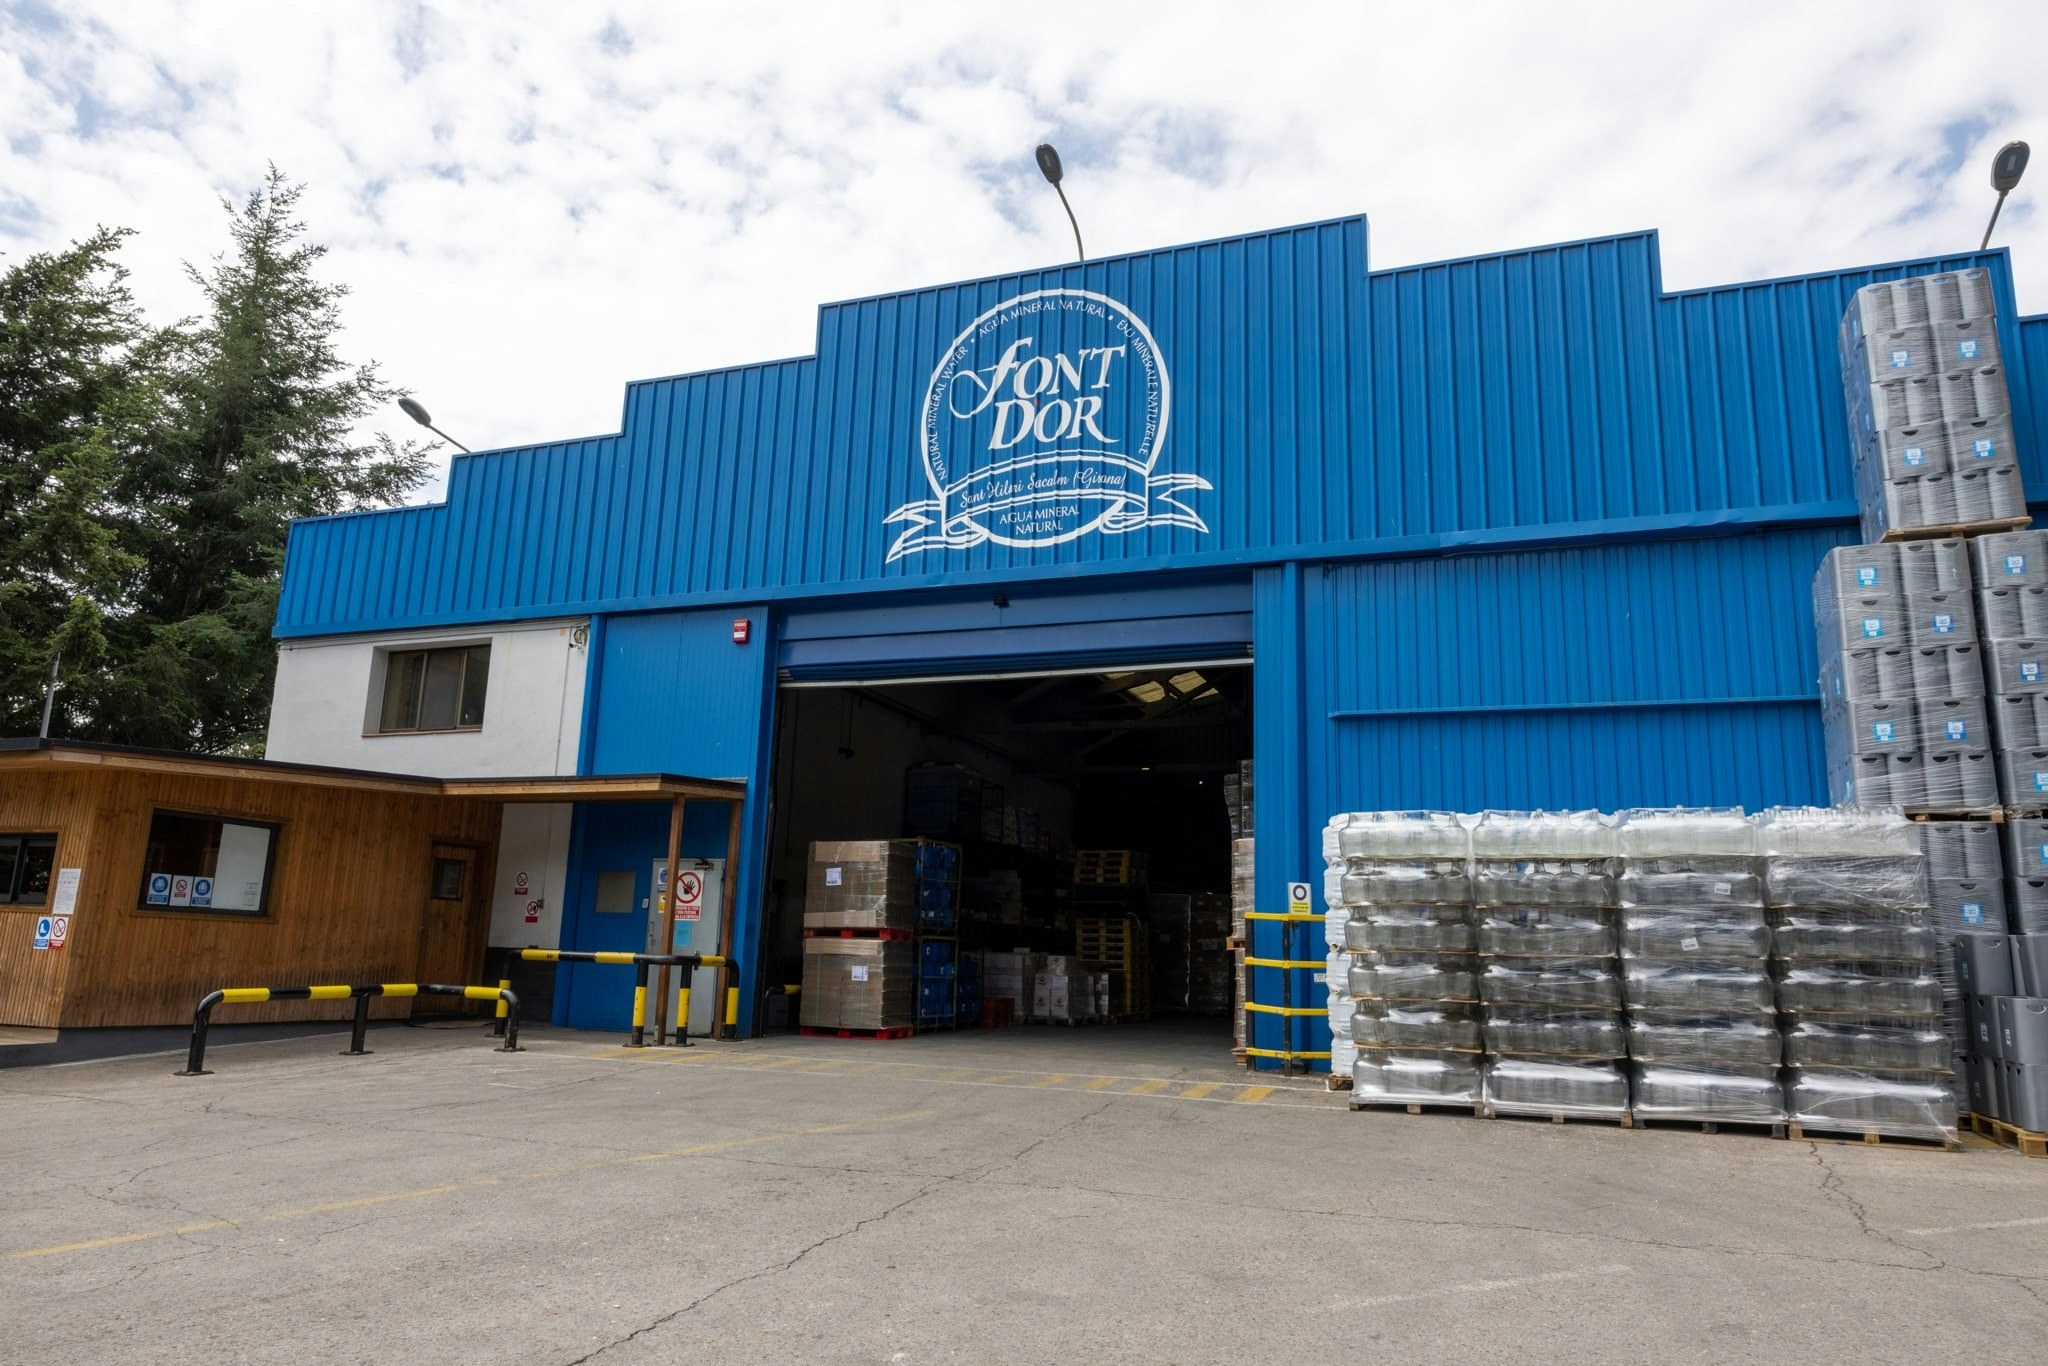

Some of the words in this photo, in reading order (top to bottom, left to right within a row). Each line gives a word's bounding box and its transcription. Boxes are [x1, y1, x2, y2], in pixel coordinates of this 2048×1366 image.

[979, 315, 1009, 338] AGUA
[1010, 301, 1056, 320] MINERAL
[1059, 299, 1106, 319] NATURAL
[941, 345, 969, 380] WATER
[928, 382, 948, 429] MINERAL
[1116, 319, 1135, 338] EAU
[1138, 391, 1159, 456] NATURELLE
[928, 431, 948, 480] NATURAL
[960, 489, 987, 508] Sant
[1027, 469, 1070, 490] Sacalm
[999, 510, 1034, 525] AIGUA
[1035, 504, 1080, 520] MINERAL
[1015, 520, 1063, 536] NATURAL
